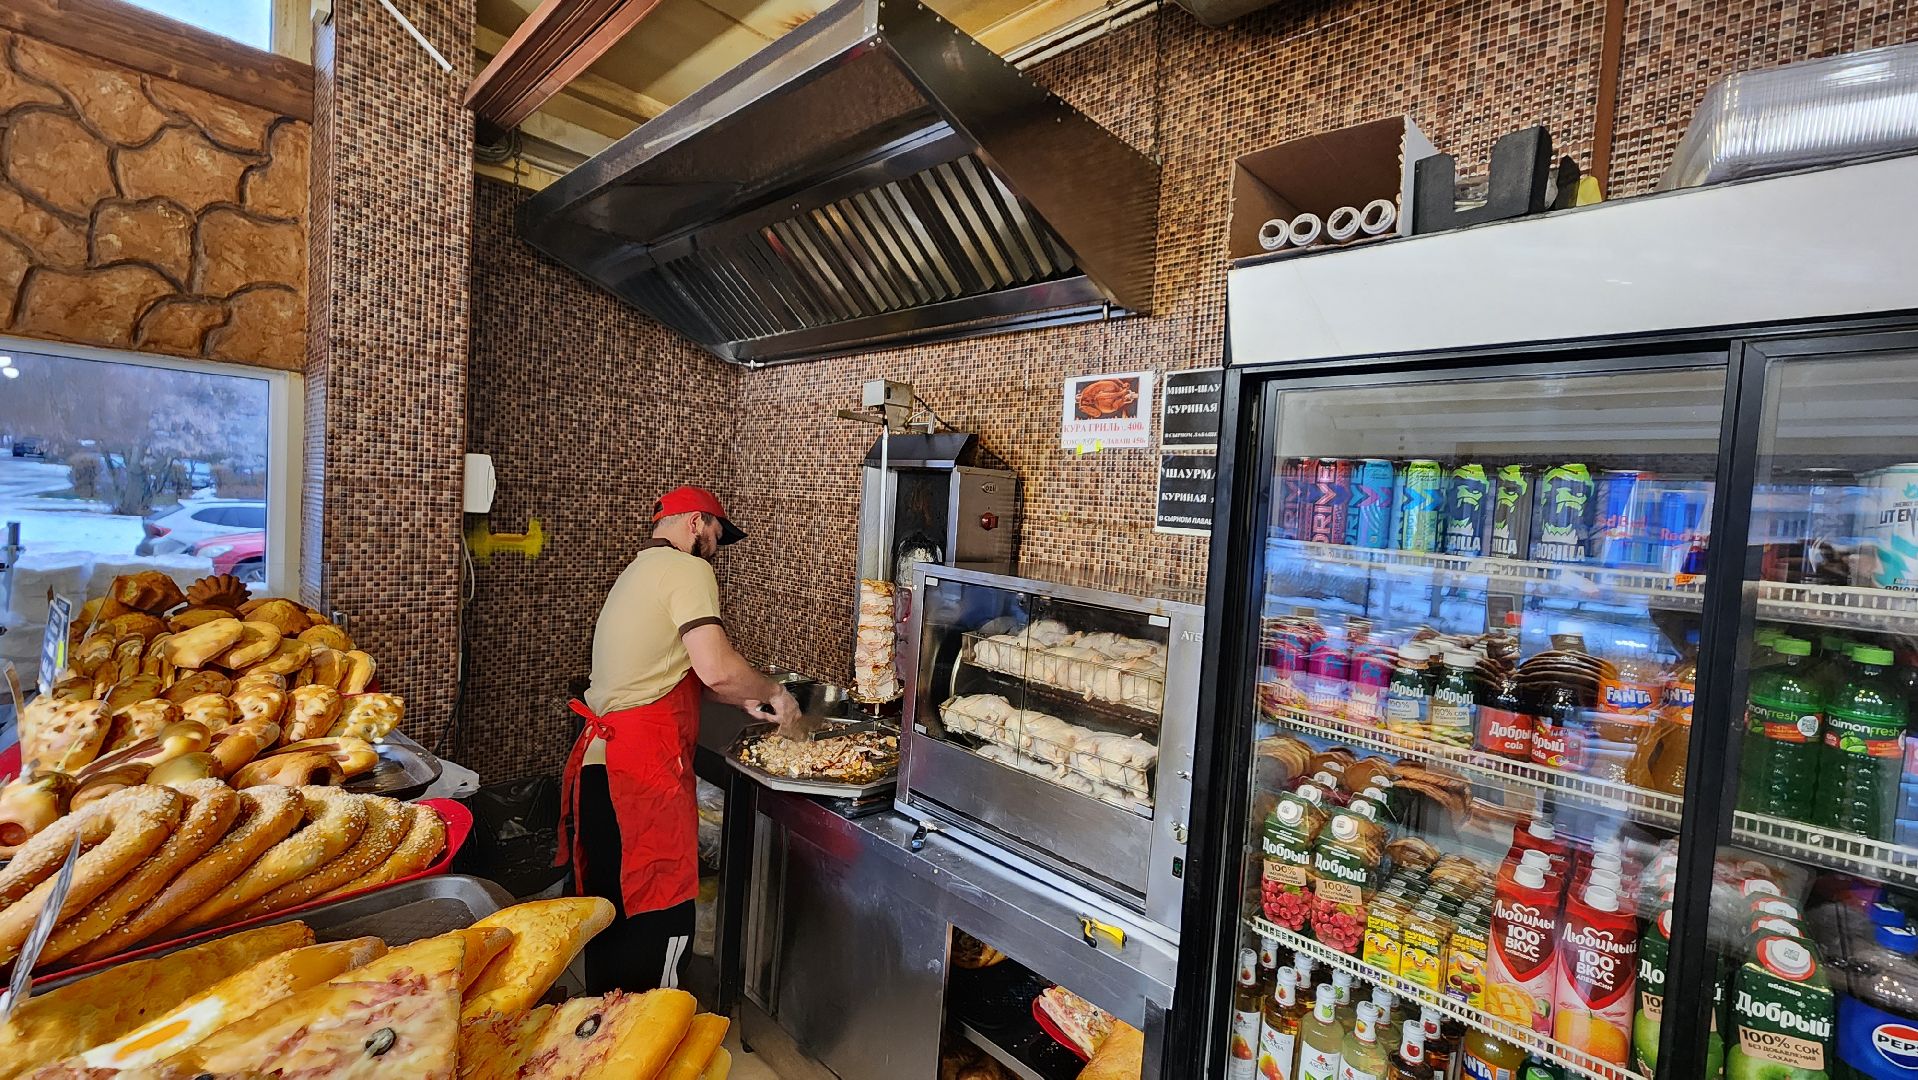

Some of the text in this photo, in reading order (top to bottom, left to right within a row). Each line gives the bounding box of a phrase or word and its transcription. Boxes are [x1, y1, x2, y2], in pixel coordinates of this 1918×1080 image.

[1167, 402, 1218, 414] КУРИНАЯ
[1063, 423, 1086, 433] КУРА
[1088, 422, 1120, 433] ГРИЛЬ
[1161, 492, 1207, 503] КУРИНАЯ
[1164, 515, 1192, 524] СЫРНОМ
[1536, 542, 1586, 562] GORILLA
[1606, 686, 1652, 705] FANTA
[1504, 741, 1524, 750] cola
[1263, 836, 1310, 865] Добрый
[1271, 864, 1297, 876] 100%
[1315, 852, 1367, 883] Добрый
[1323, 881, 1352, 894] 100%
[1493, 899, 1555, 930] Любимы
[1505, 936, 1540, 958] ВКУС
[1562, 922, 1637, 954] Любимый
[1576, 961, 1615, 985] ВКУС
[1576, 974, 1613, 991] АПЕЛЬСИН
[1767, 982, 1802, 997] яблоко
[1736, 990, 1831, 1038] Добрый
[1742, 1029, 1821, 1056] 100% СОК
[1877, 1033, 1918, 1054] PEP
[1767, 1053, 1800, 1065] САХАРА
